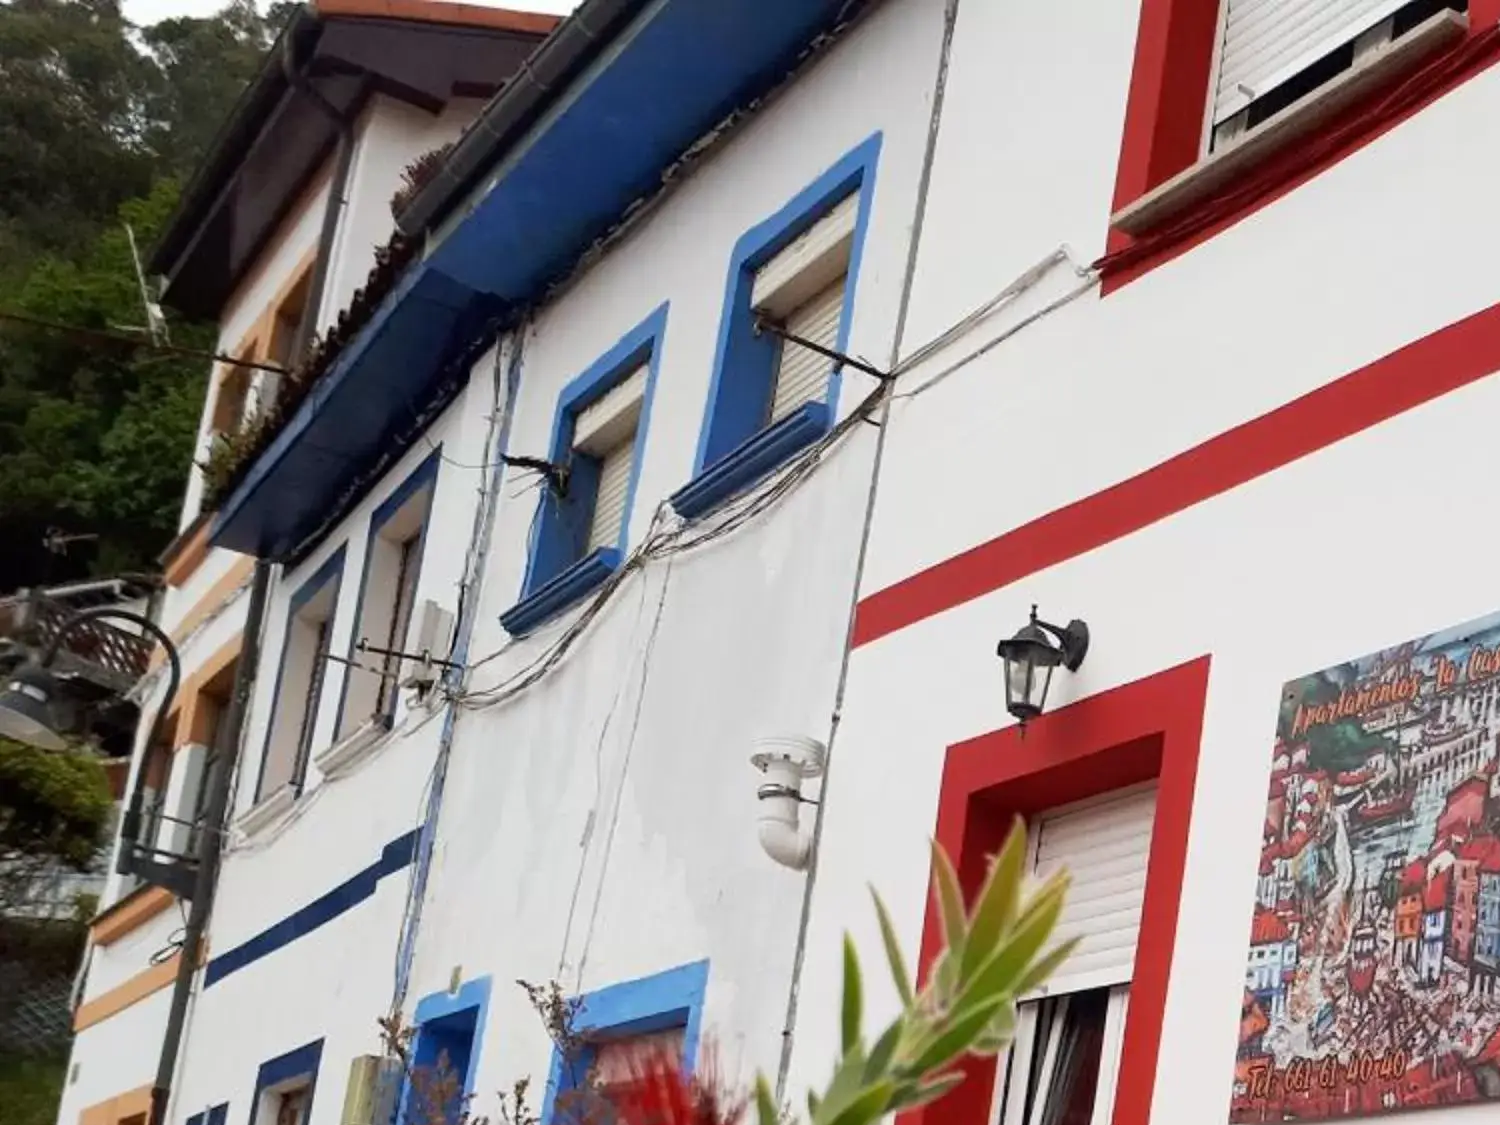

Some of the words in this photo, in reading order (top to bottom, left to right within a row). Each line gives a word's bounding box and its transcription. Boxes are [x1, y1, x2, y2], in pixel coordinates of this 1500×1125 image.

[1291, 670, 1421, 740] Apartamentos
[1285, 1056, 1314, 1093] 661
[1319, 1053, 1339, 1089] 61
